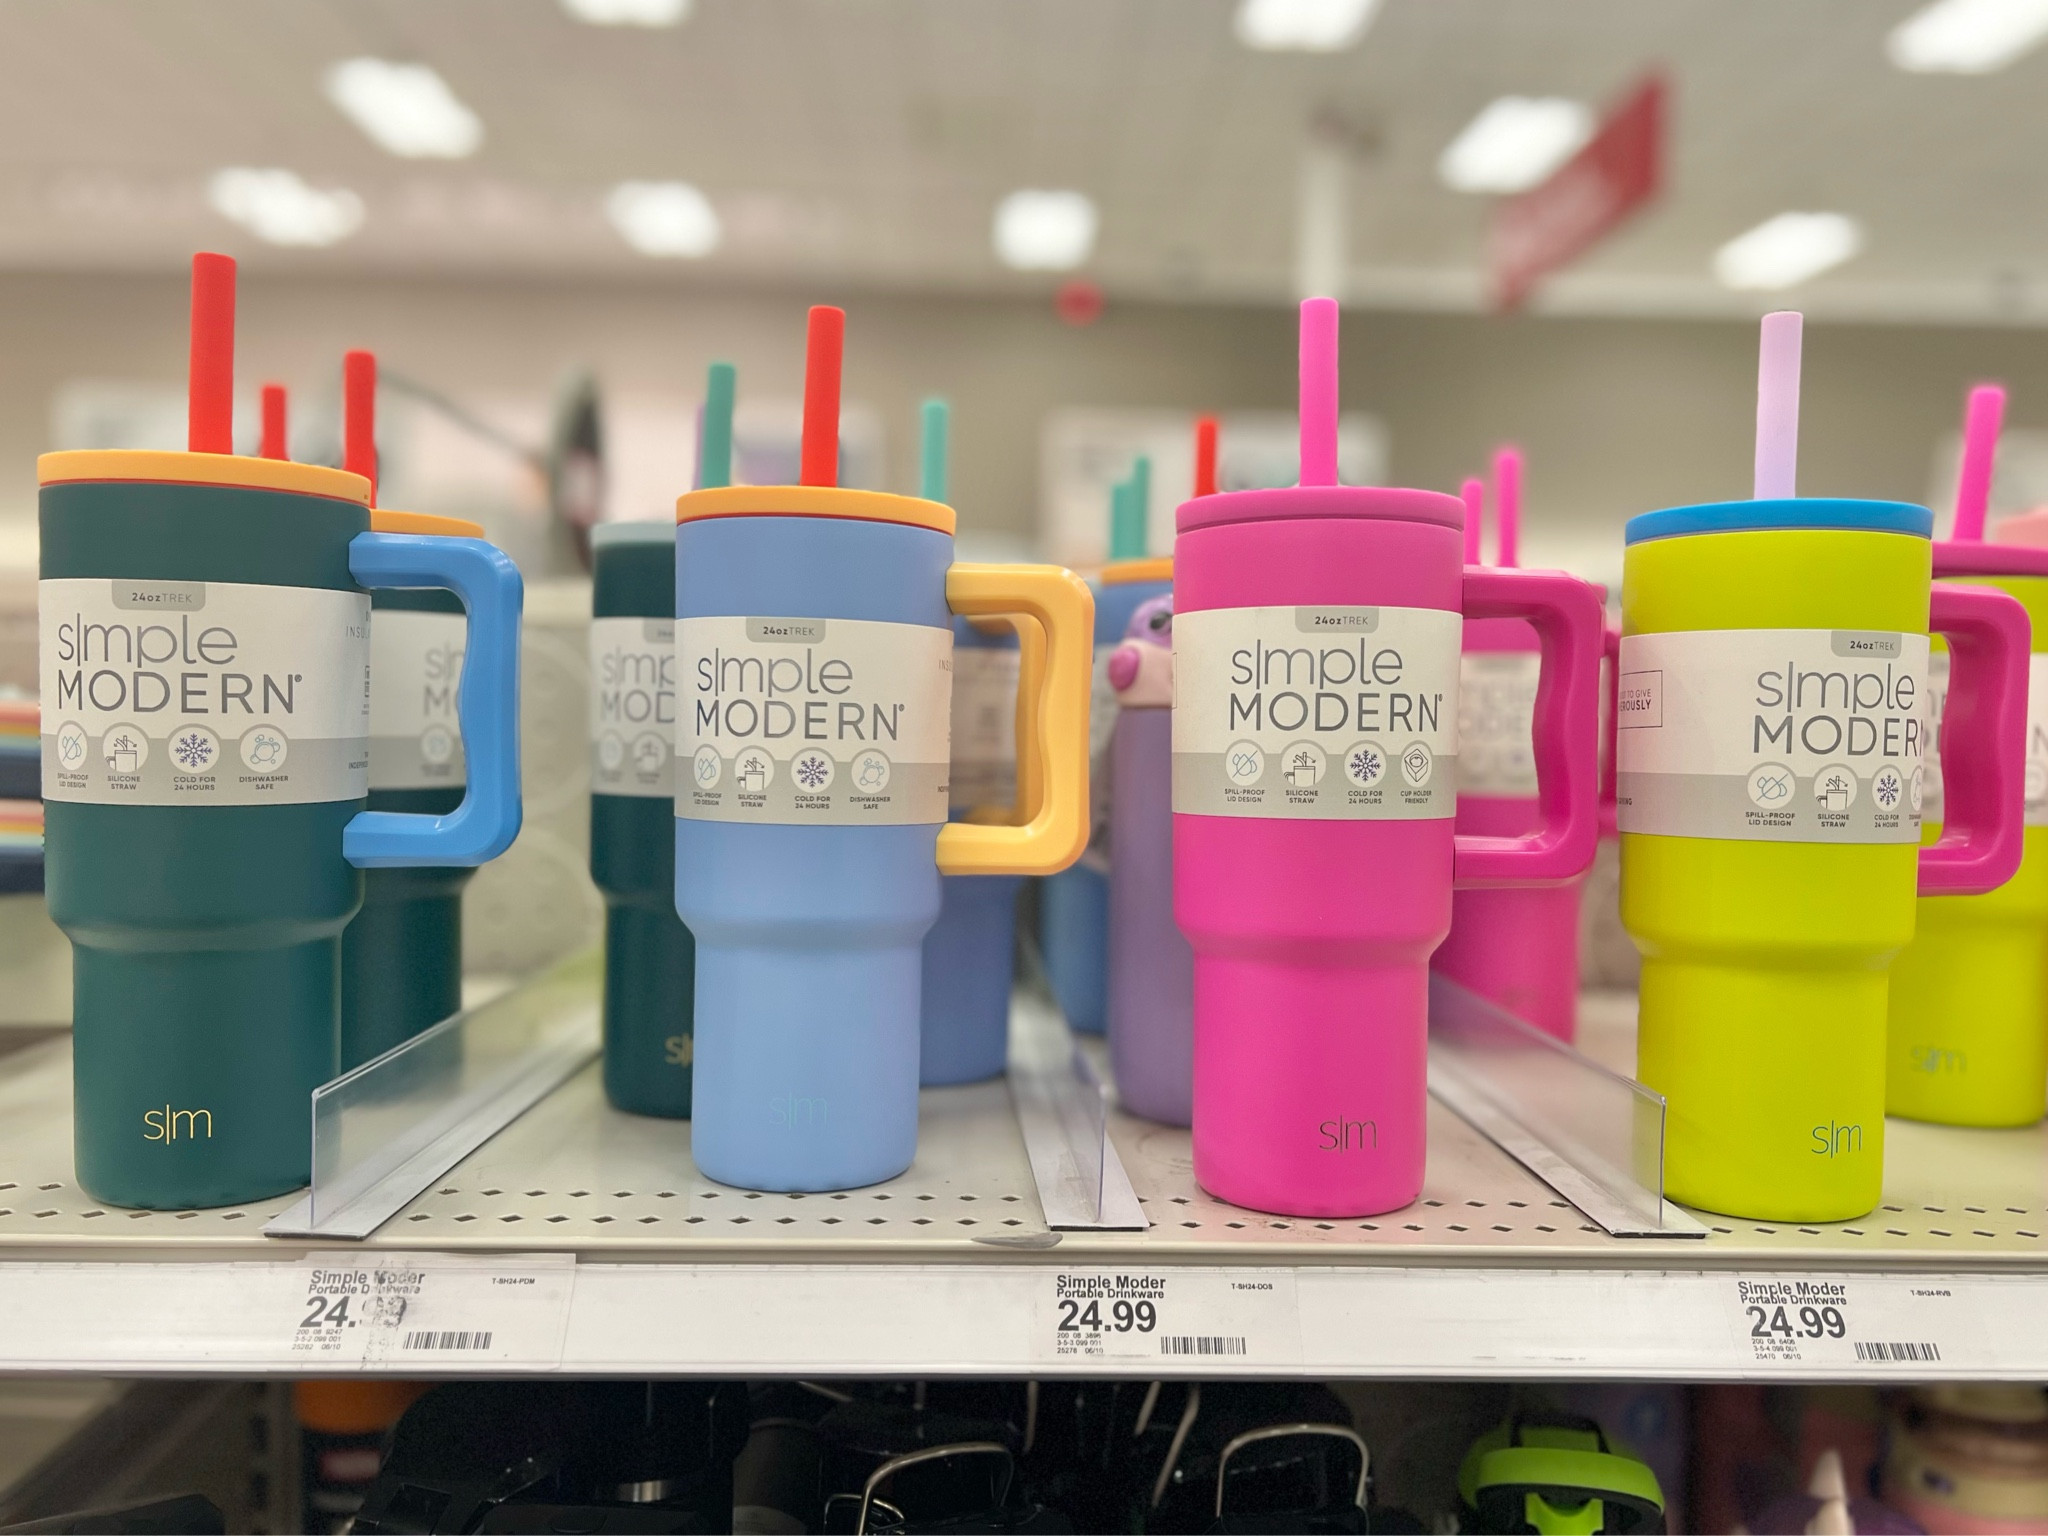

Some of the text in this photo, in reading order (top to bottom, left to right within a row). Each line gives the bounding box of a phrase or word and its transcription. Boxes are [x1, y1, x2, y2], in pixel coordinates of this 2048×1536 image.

[1635, 689, 1651, 698] GIVE
[239, 775, 289, 783] DISHWASHER
[1224, 788, 1265, 796] SPILL-PROOF
[1745, 811, 1796, 819] SPILL-PROOF
[310, 1270, 367, 1288] Simple
[1057, 1274, 1166, 1293] Simple Moder
[309, 1284, 357, 1294] Portable
[1057, 1288, 1164, 1299] Portable Drinkware
[1738, 1281, 1845, 1300] Simple Moder
[1741, 1294, 1847, 1305] Portable Drinkware
[1058, 1300, 1157, 1333] 24.99
[1746, 1306, 1846, 1339] 24.99
